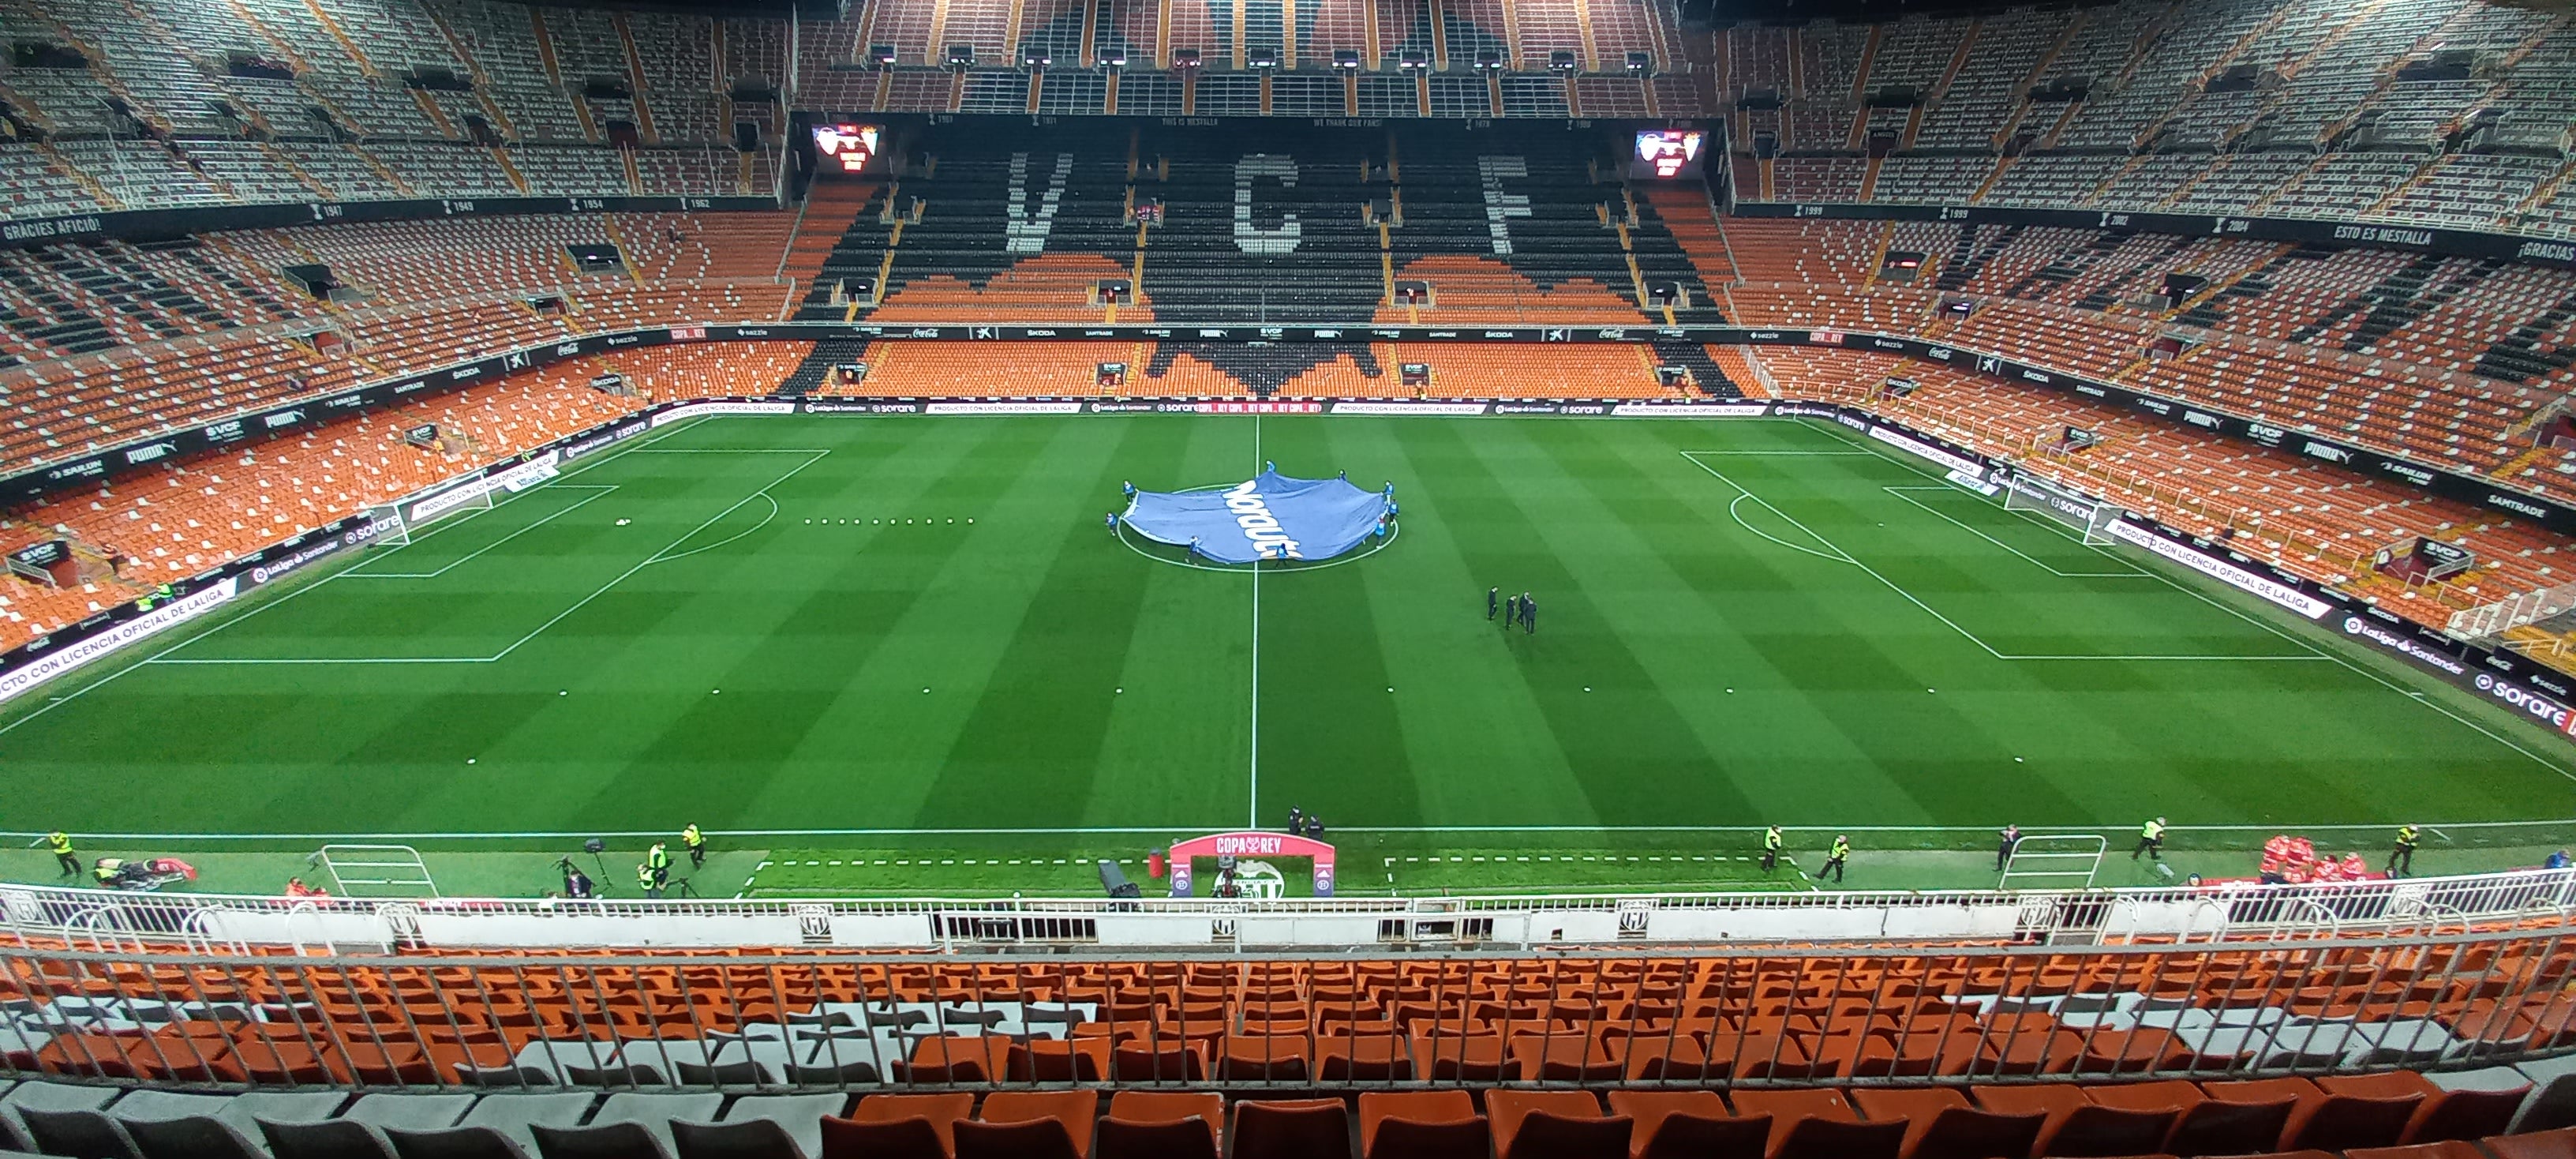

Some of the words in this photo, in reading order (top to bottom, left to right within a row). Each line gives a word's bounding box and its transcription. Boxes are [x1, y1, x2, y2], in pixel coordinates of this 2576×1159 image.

[324, 205, 343, 218] 1947
[583, 199, 604, 209] 1954
[1005, 152, 1073, 253] V
[1234, 154, 1301, 254] C
[1805, 207, 1823, 216] 1999
[1949, 209, 1968, 219] 1999
[3, 222, 55, 241] GRÀCIES
[58, 217, 103, 234] AFICIÓ!
[2226, 221, 2249, 232] 2004
[2334, 225, 2359, 239] ESTO
[2361, 227, 2376, 241] ES
[2377, 228, 2432, 246] MESTALLA
[2517, 241, 2575, 261] ¡GRACIAS
[1810, 332, 1825, 342] COPA
[1831, 333, 1844, 343] REY
[657, 411, 678, 422] PRODUCTO
[1218, 403, 1228, 412] REY
[264, 411, 298, 429] PUMA
[1843, 415, 1866, 431] sorare
[2184, 410, 2212, 427] PUMA
[621, 422, 646, 437] sorare
[126, 443, 167, 464] PUMA
[1874, 429, 1898, 443] PRODUCTO
[1897, 437, 1908, 447] CON
[1908, 441, 1928, 456] LICENCIA
[1929, 449, 1948, 463] OFICIAL
[1948, 457, 1956, 466] DE
[1956, 460, 1974, 473] LALIGA
[2304, 441, 2340, 462] PUMA
[2392, 465, 2434, 481] SAILUN
[421, 494, 456, 513] PRODUCTO
[457, 489, 471, 500] CON
[501, 469, 523, 483] OFICIAL
[533, 457, 552, 470] LALIGA
[2020, 485, 2046, 501] Santander
[2059, 500, 2097, 523] sorare
[357, 514, 400, 538] sorare
[267, 557, 294, 576] LaLiga
[302, 540, 339, 560] Santander
[2116, 523, 2157, 546] PRODUCTO
[2158, 540, 2177, 557] CON
[2178, 549, 2217, 572] LICENCIA
[2219, 564, 2256, 588] OFICIAL
[2257, 582, 2272, 595] DE
[2273, 587, 2309, 611] LALIGA
[31, 658, 61, 678] CON
[60, 634, 122, 664] LICENCIA
[123, 613, 170, 639] OFICIAL
[171, 605, 185, 618] DE
[188, 588, 224, 611] LALIGA
[2361, 625, 2398, 647] LaLiga
[2409, 645, 2464, 675] Santander
[2492, 681, 2567, 727] sorare
[1216, 837, 1246, 853] COPA
[1260, 837, 1282, 853] REY
